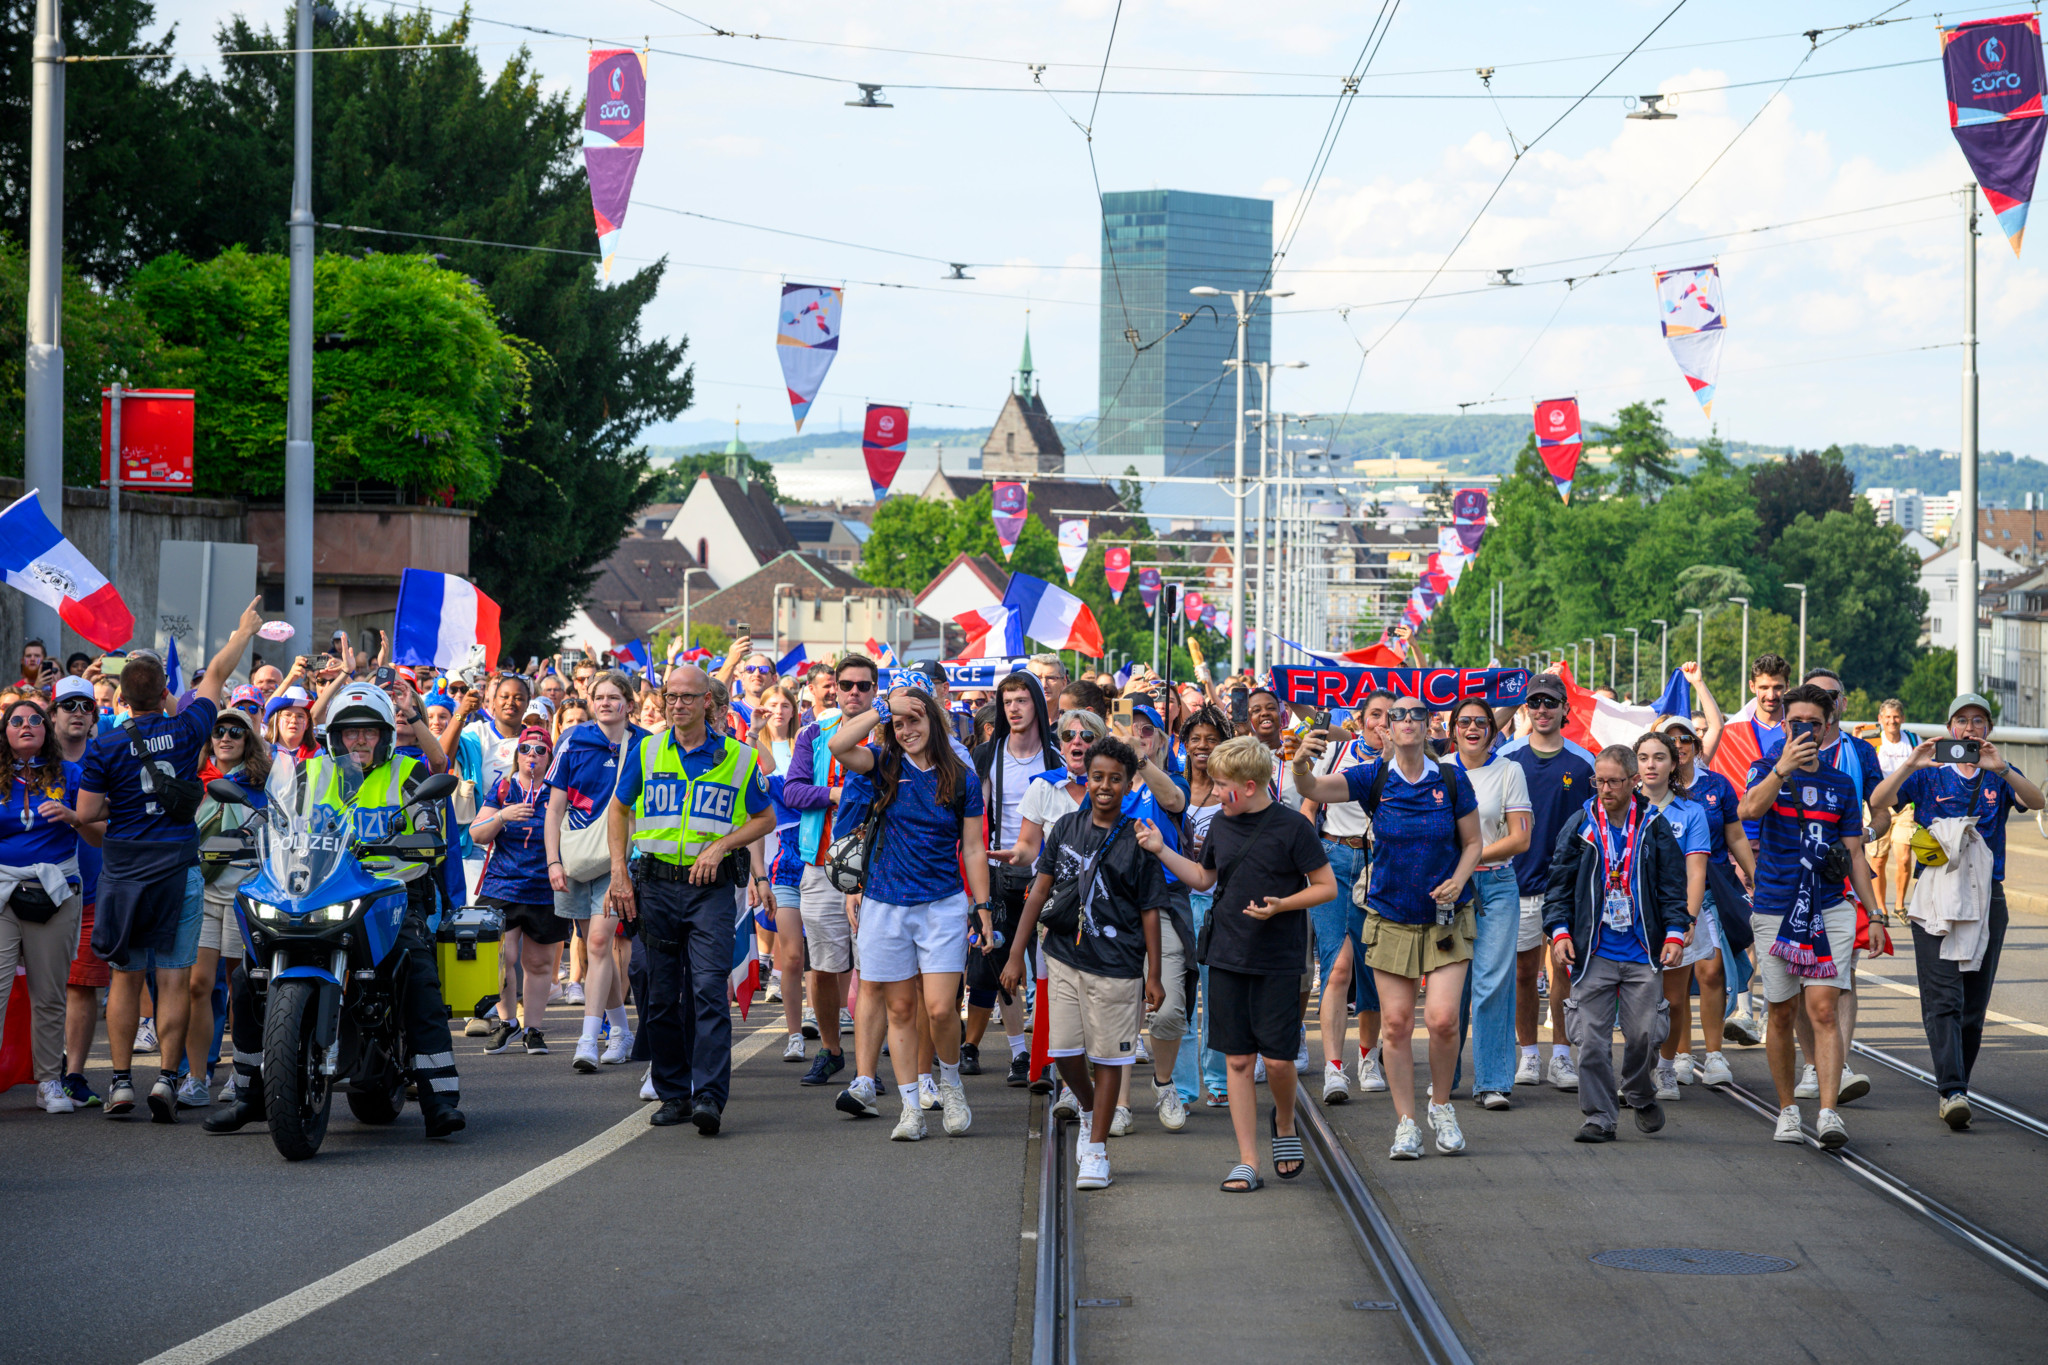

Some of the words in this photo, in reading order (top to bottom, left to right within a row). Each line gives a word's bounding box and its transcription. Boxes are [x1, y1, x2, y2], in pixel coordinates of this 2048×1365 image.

[1287, 668, 1489, 710] FRANCE
[130, 734, 174, 756] GROUD
[645, 783, 735, 819] POLIZEI
[271, 835, 340, 852] POLIZEI
[522, 828, 532, 849] 7
